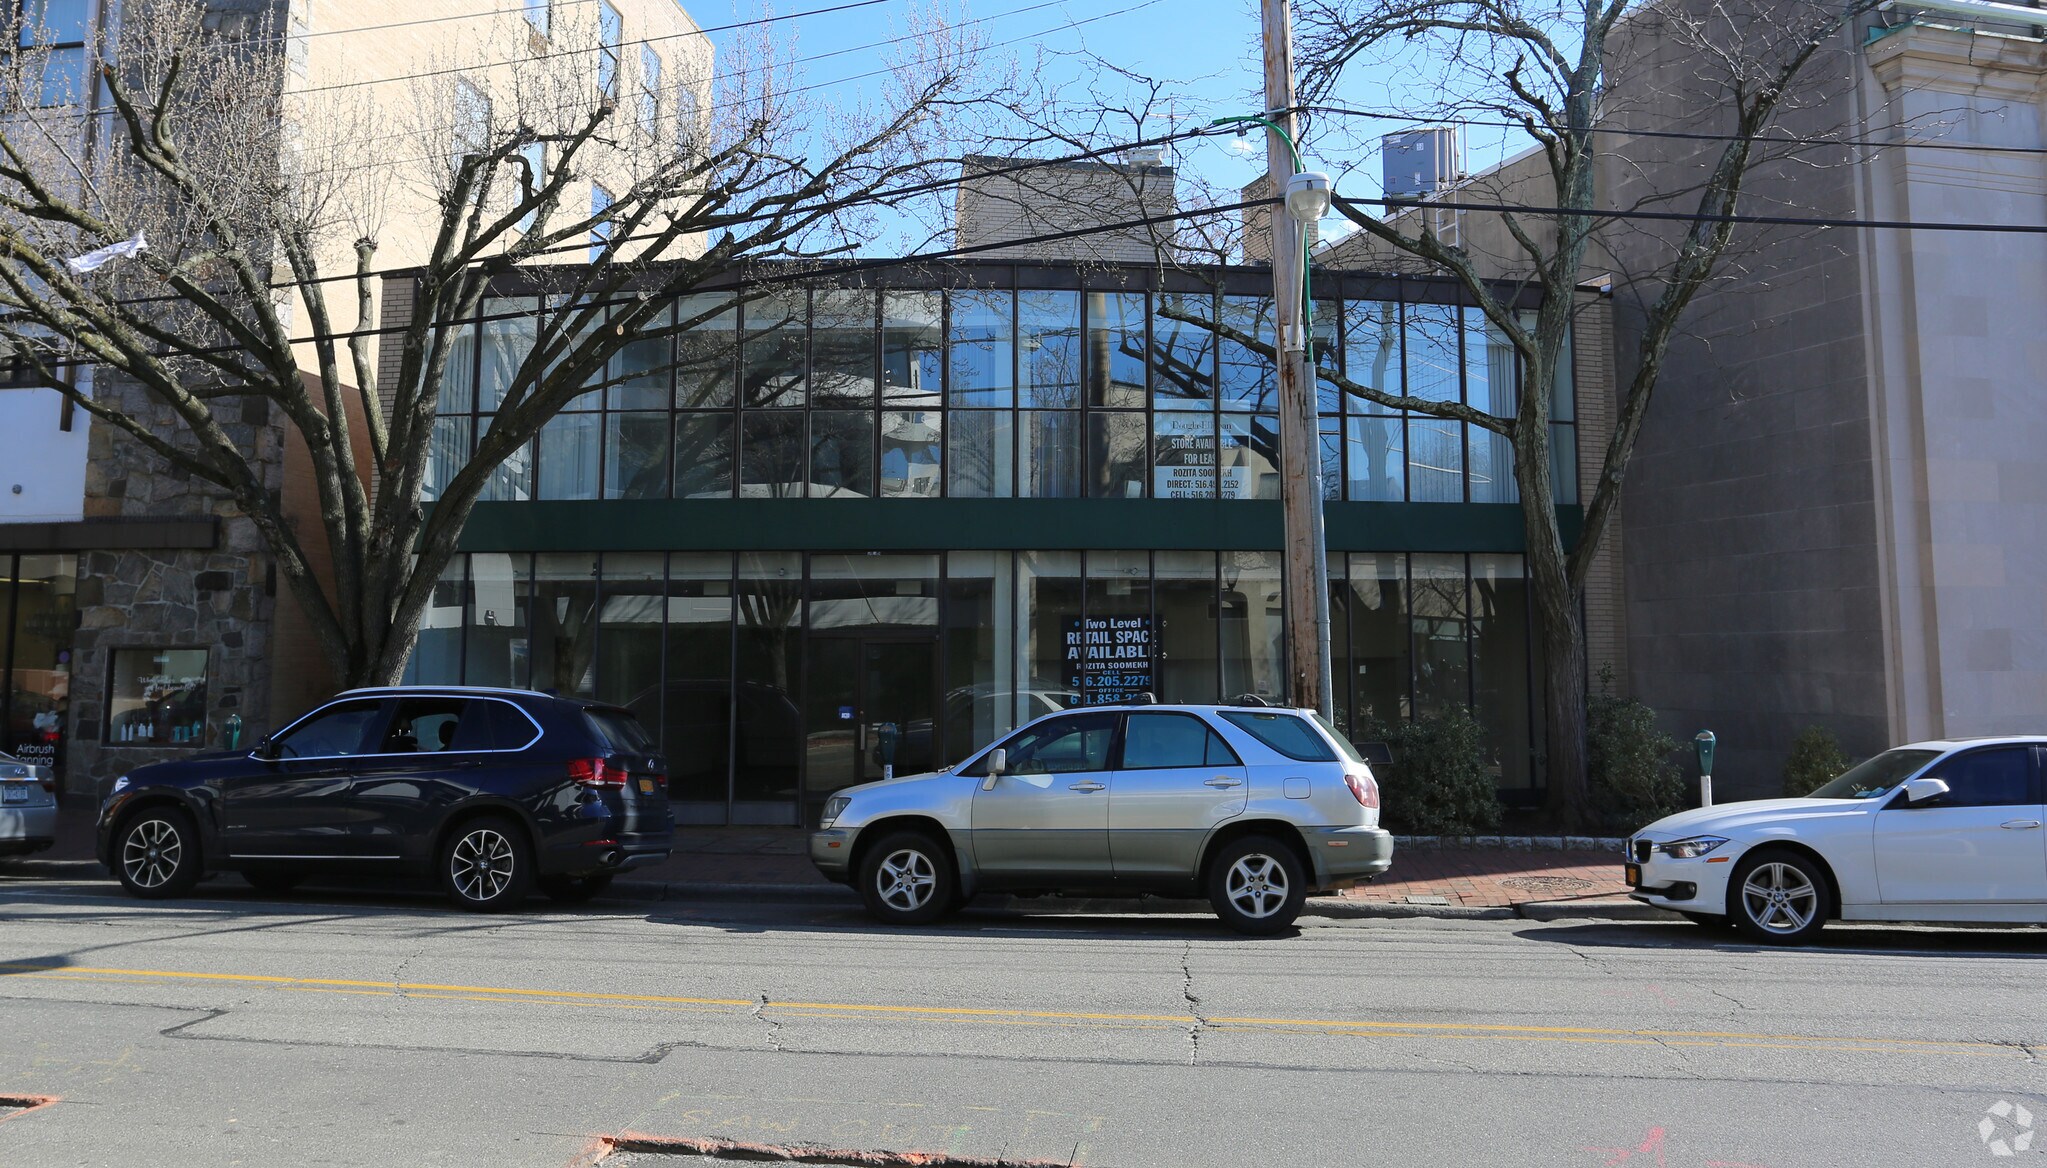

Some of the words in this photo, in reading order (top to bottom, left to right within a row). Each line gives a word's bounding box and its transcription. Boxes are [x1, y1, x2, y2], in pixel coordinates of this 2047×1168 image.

[1171, 438, 1194, 449] STORE
[1184, 453, 1198, 465] FOR
[1200, 453, 1216, 464] LEAS
[1173, 468, 1197, 478] ROZITA
[1167, 480, 1194, 489] DIRECT:
[1085, 618, 1107, 629] Two
[1110, 617, 1141, 629] Level
[1115, 630, 1149, 644] SPAC
[1067, 645, 1151, 660] AVAILABL
[1076, 662, 1106, 670] RZITA
[1107, 661, 1149, 669] SOOMEKH
[1072, 675, 1151, 687] 56.205.2279
[16, 743, 55, 754] Airbrush
